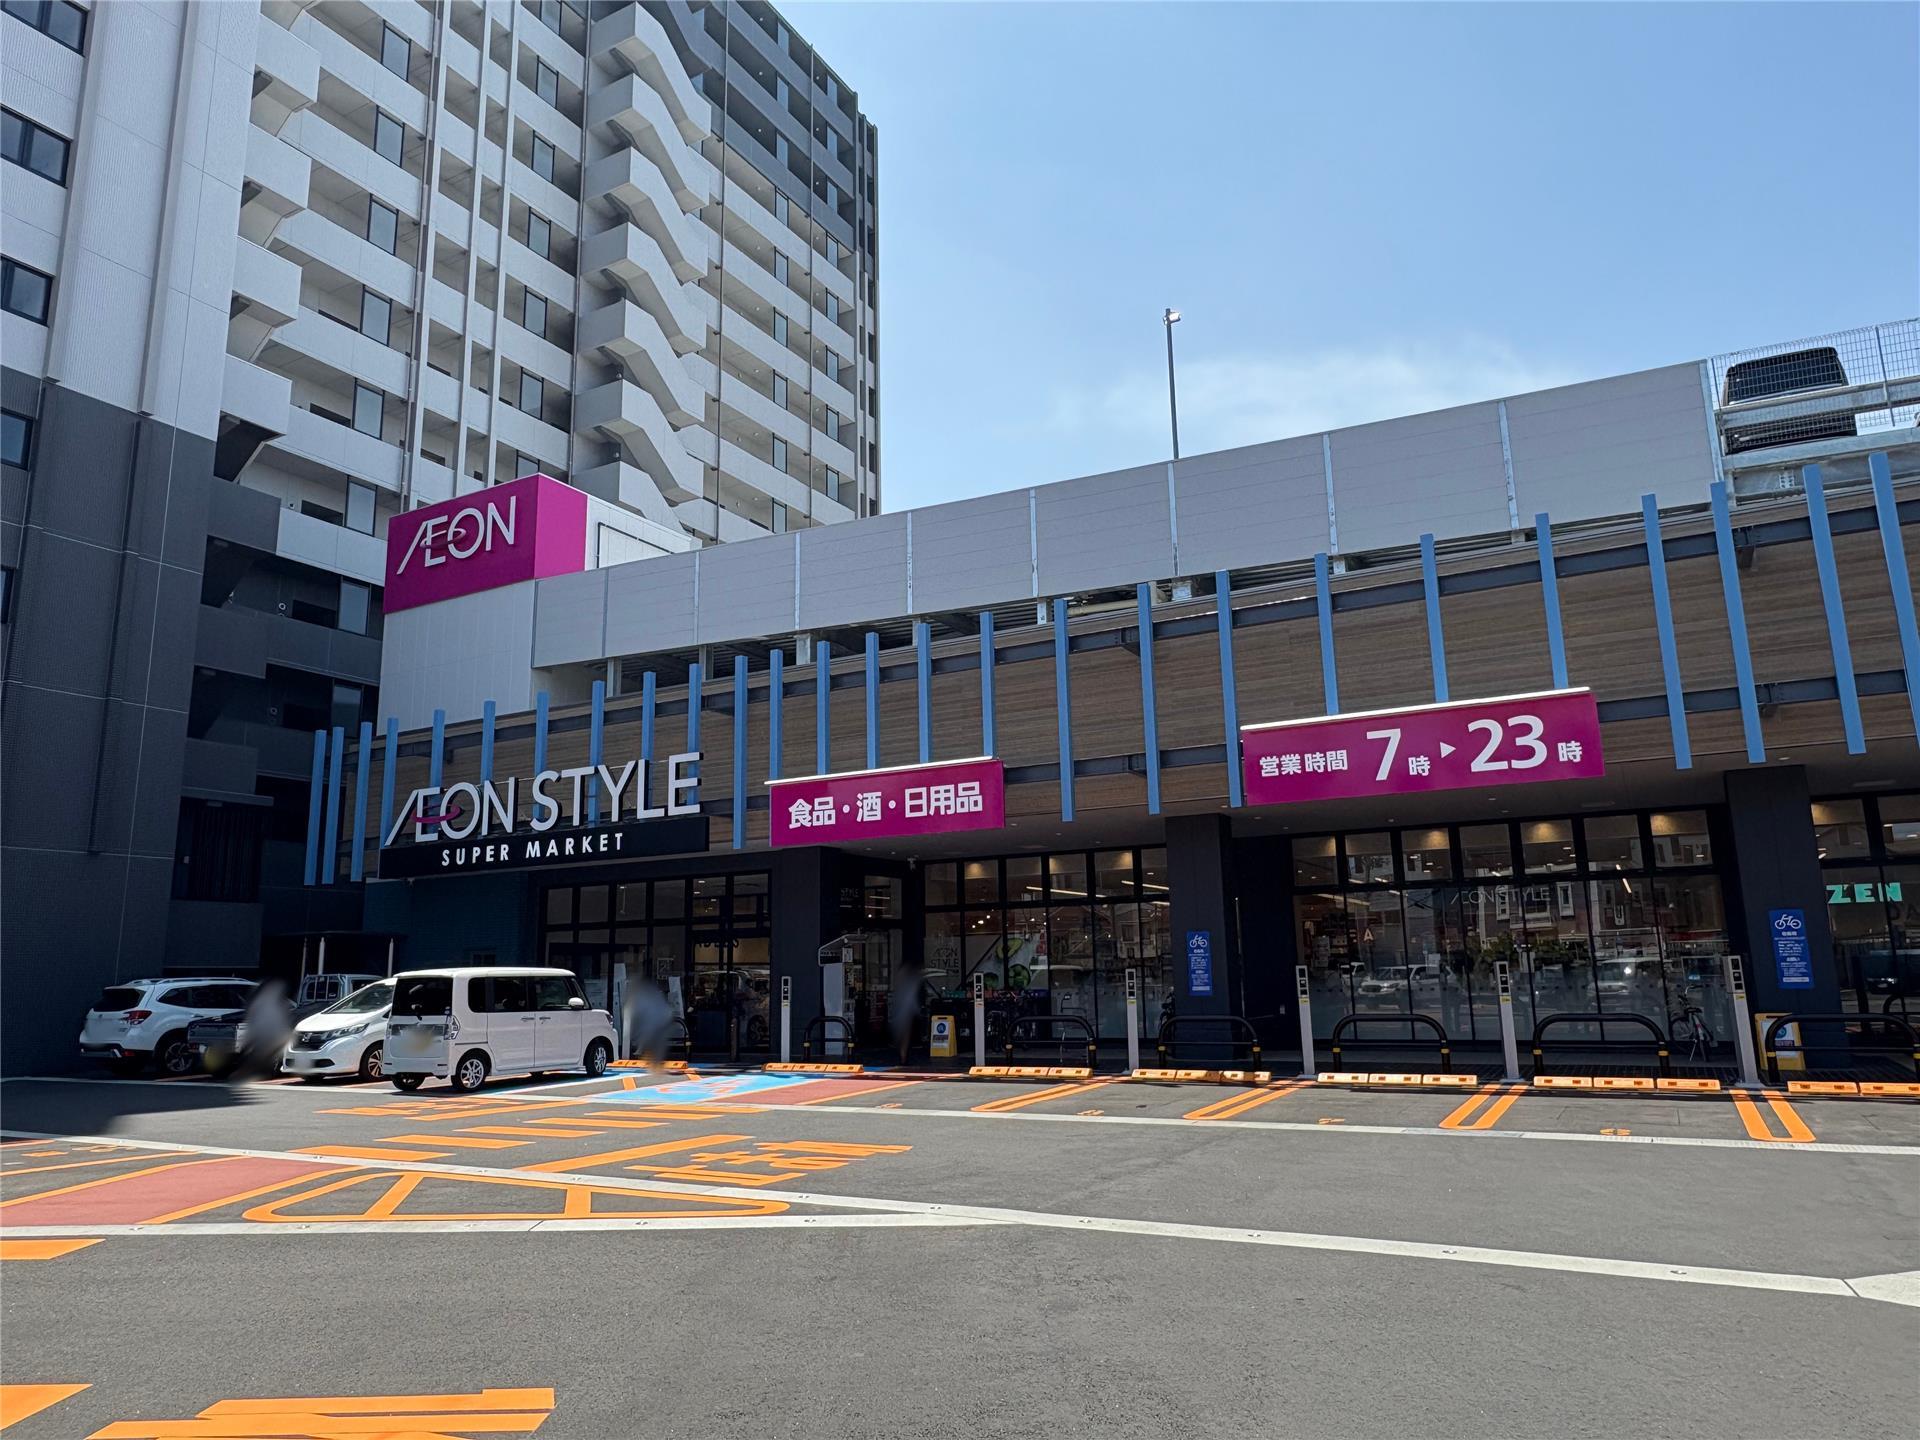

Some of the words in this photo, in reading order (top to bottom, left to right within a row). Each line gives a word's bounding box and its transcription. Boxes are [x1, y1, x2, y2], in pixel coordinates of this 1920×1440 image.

[1259, 750, 1349, 778] 営業時間
[1366, 728, 1431, 782] 7時
[1467, 714, 1583, 773] 23時
[529, 751, 702, 832] STYLE
[788, 781, 983, 829] 食品・酒・日用品
[441, 844, 510, 867] SUPER
[525, 832, 624, 859] MARKET
